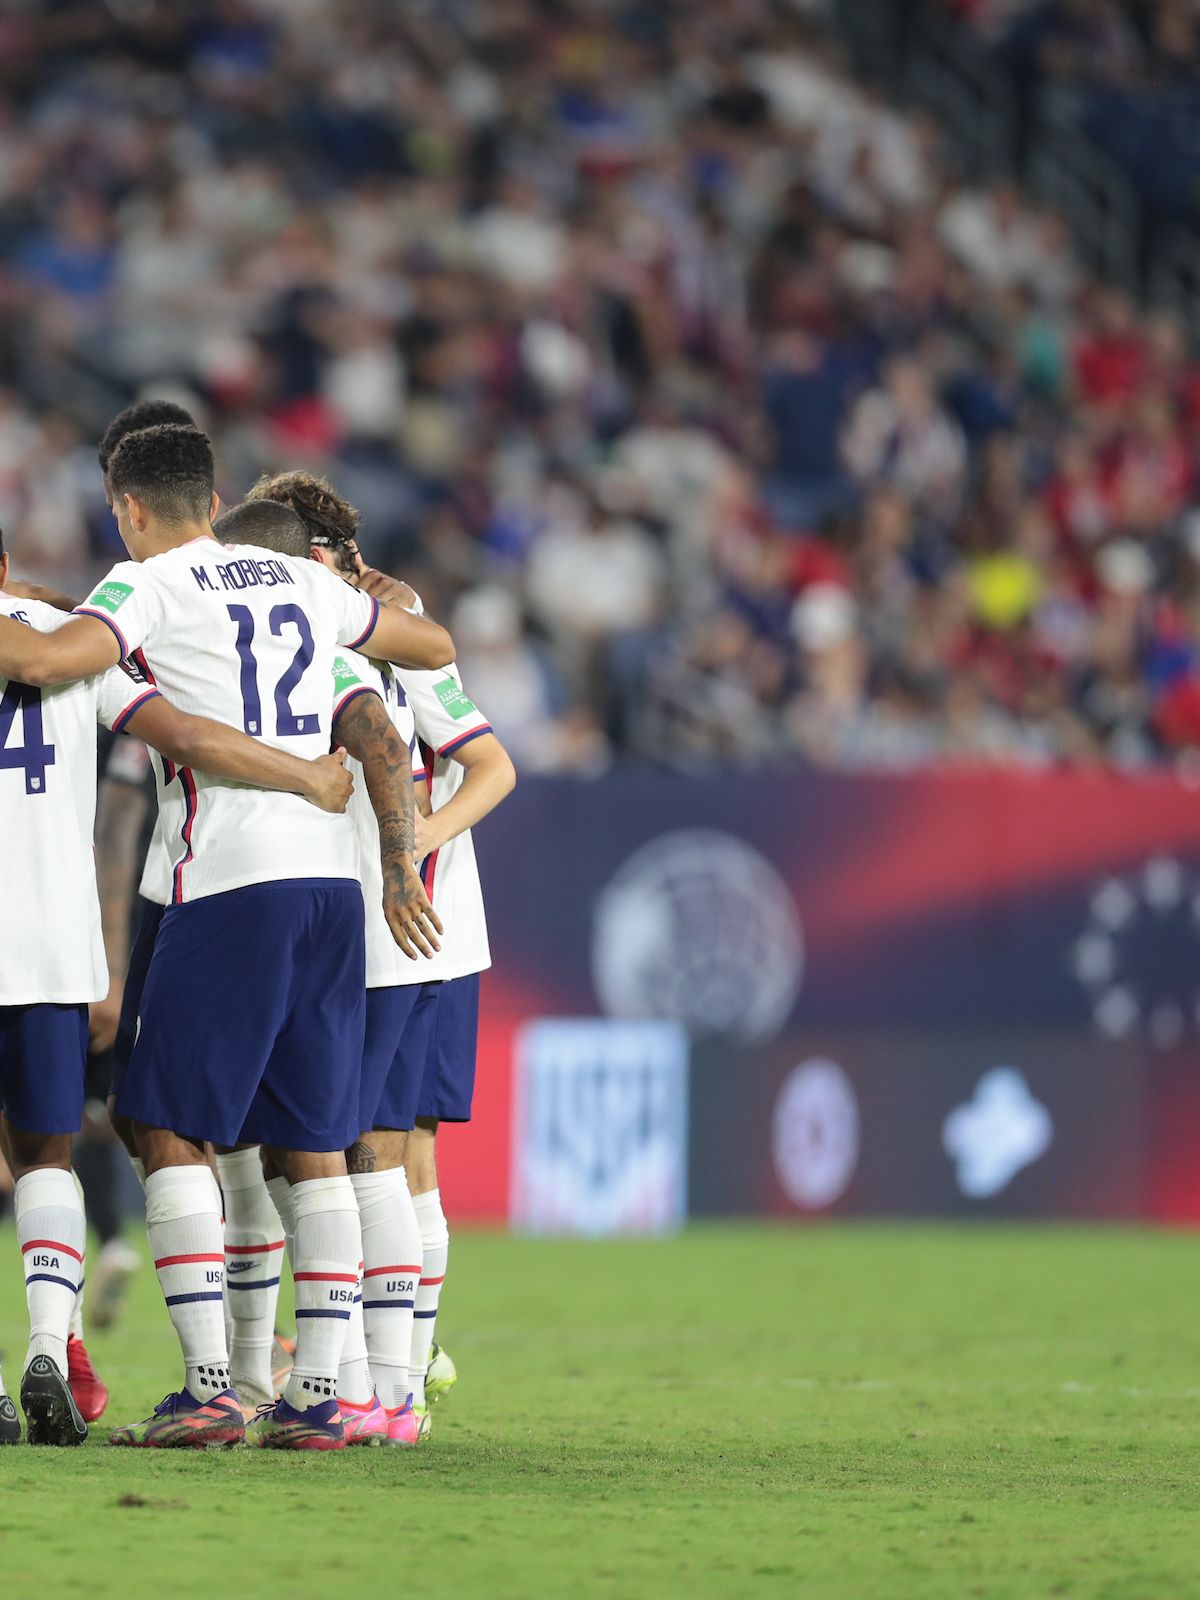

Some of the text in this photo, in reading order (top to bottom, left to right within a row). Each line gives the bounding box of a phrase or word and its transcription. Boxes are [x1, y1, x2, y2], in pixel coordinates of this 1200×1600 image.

[190, 565, 219, 591] M.
[226, 603, 321, 736] 12
[33, 1255, 60, 1269] USA
[386, 1281, 414, 1293] USA
[329, 1289, 354, 1303] USA
